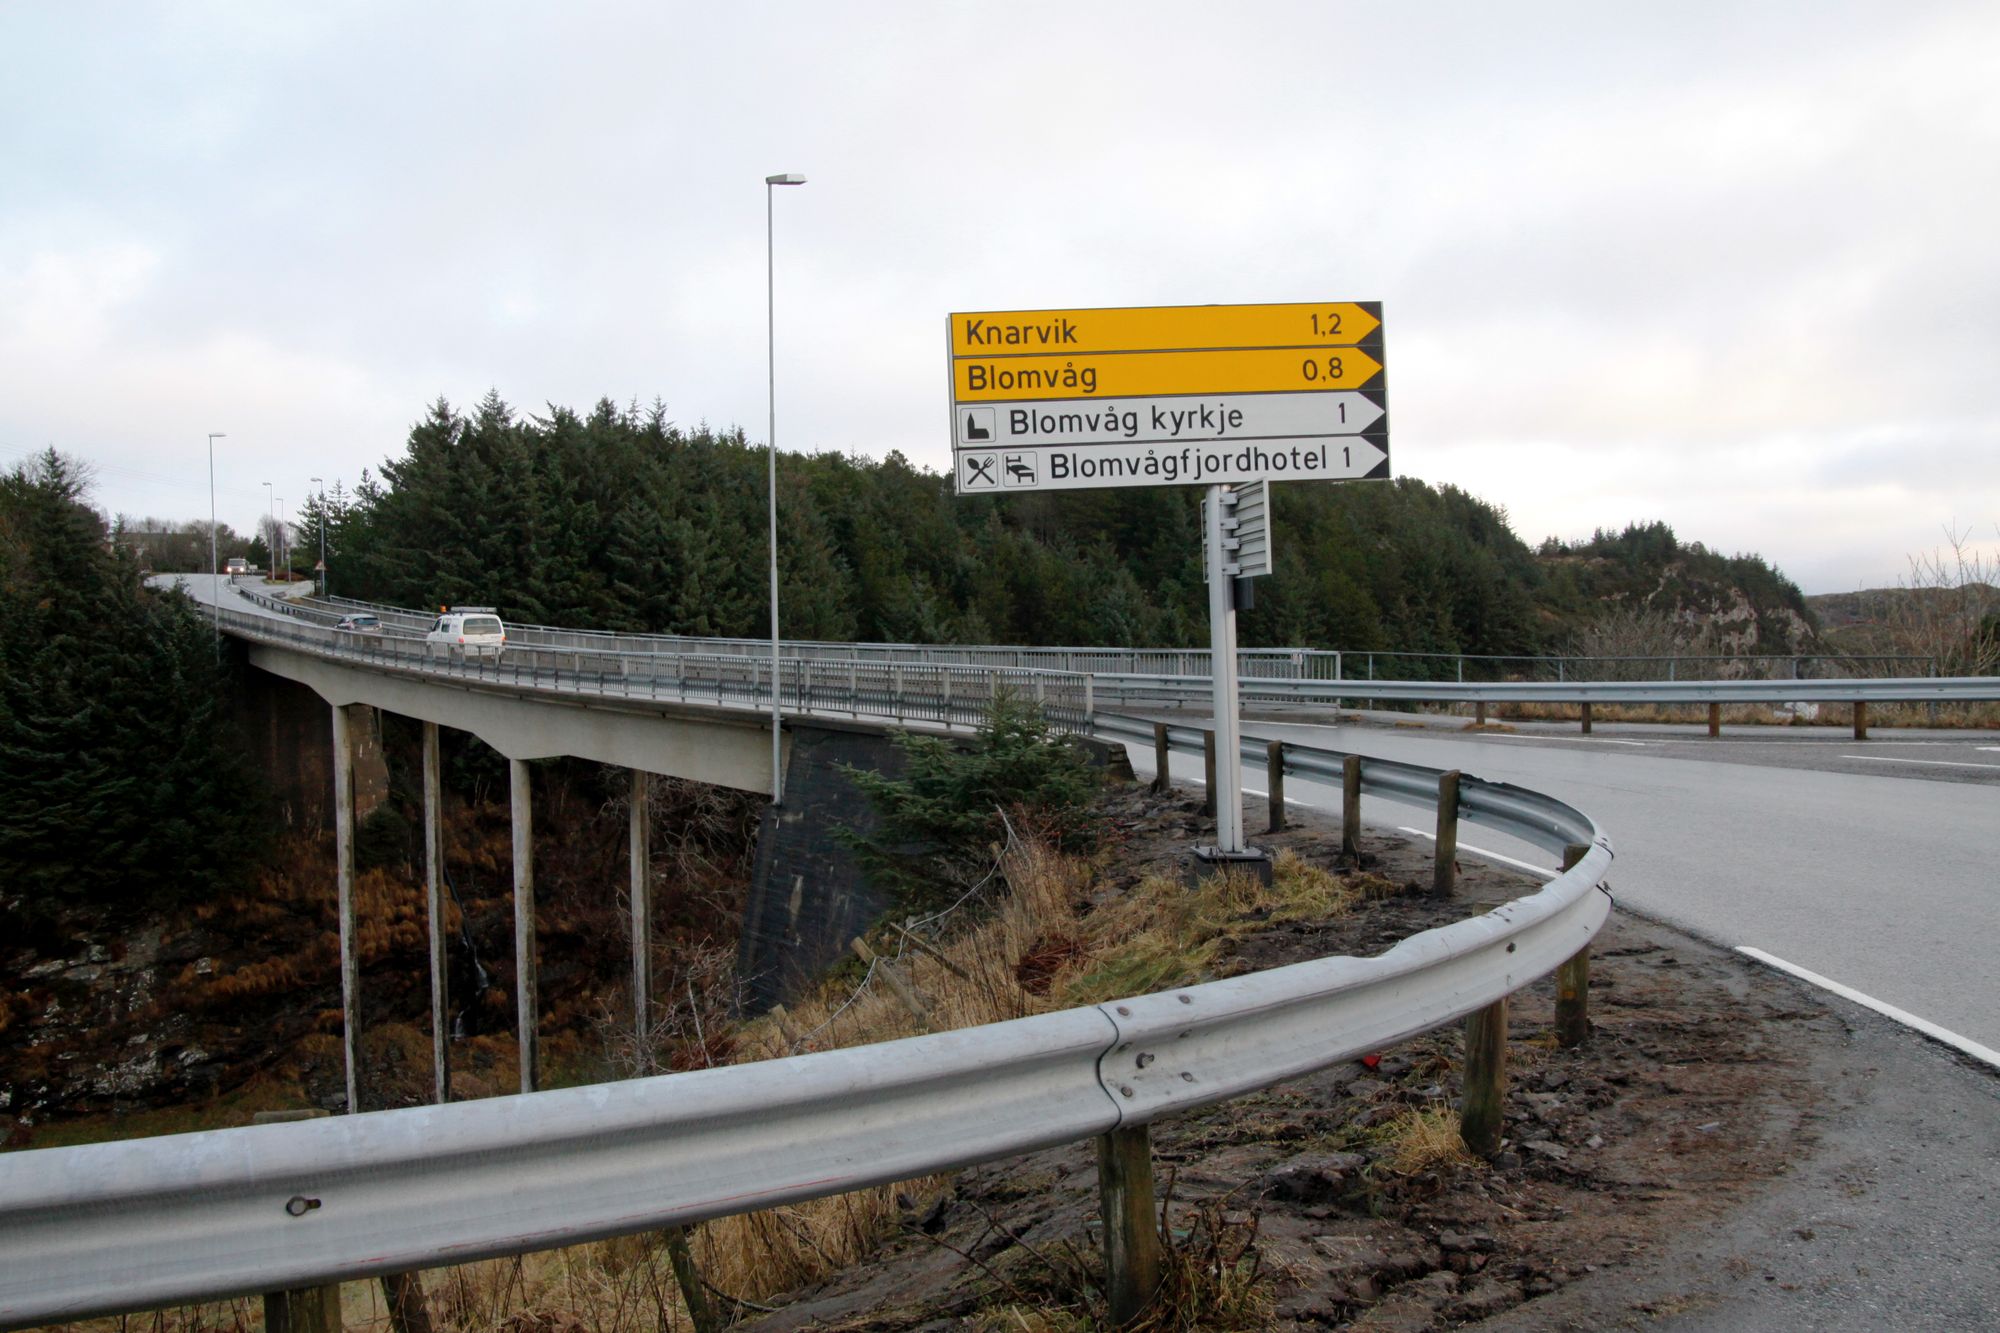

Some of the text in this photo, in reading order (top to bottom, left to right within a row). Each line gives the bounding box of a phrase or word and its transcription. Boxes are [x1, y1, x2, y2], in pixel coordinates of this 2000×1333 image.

[967, 313, 1342, 344] Knarvik 1,2
[968, 357, 1344, 393] Blomvåg 0,8
[1010, 402, 1346, 437] Blomvåg kyrkje 1
[1051, 445, 1351, 480] Blomvågfjordhotel 1
